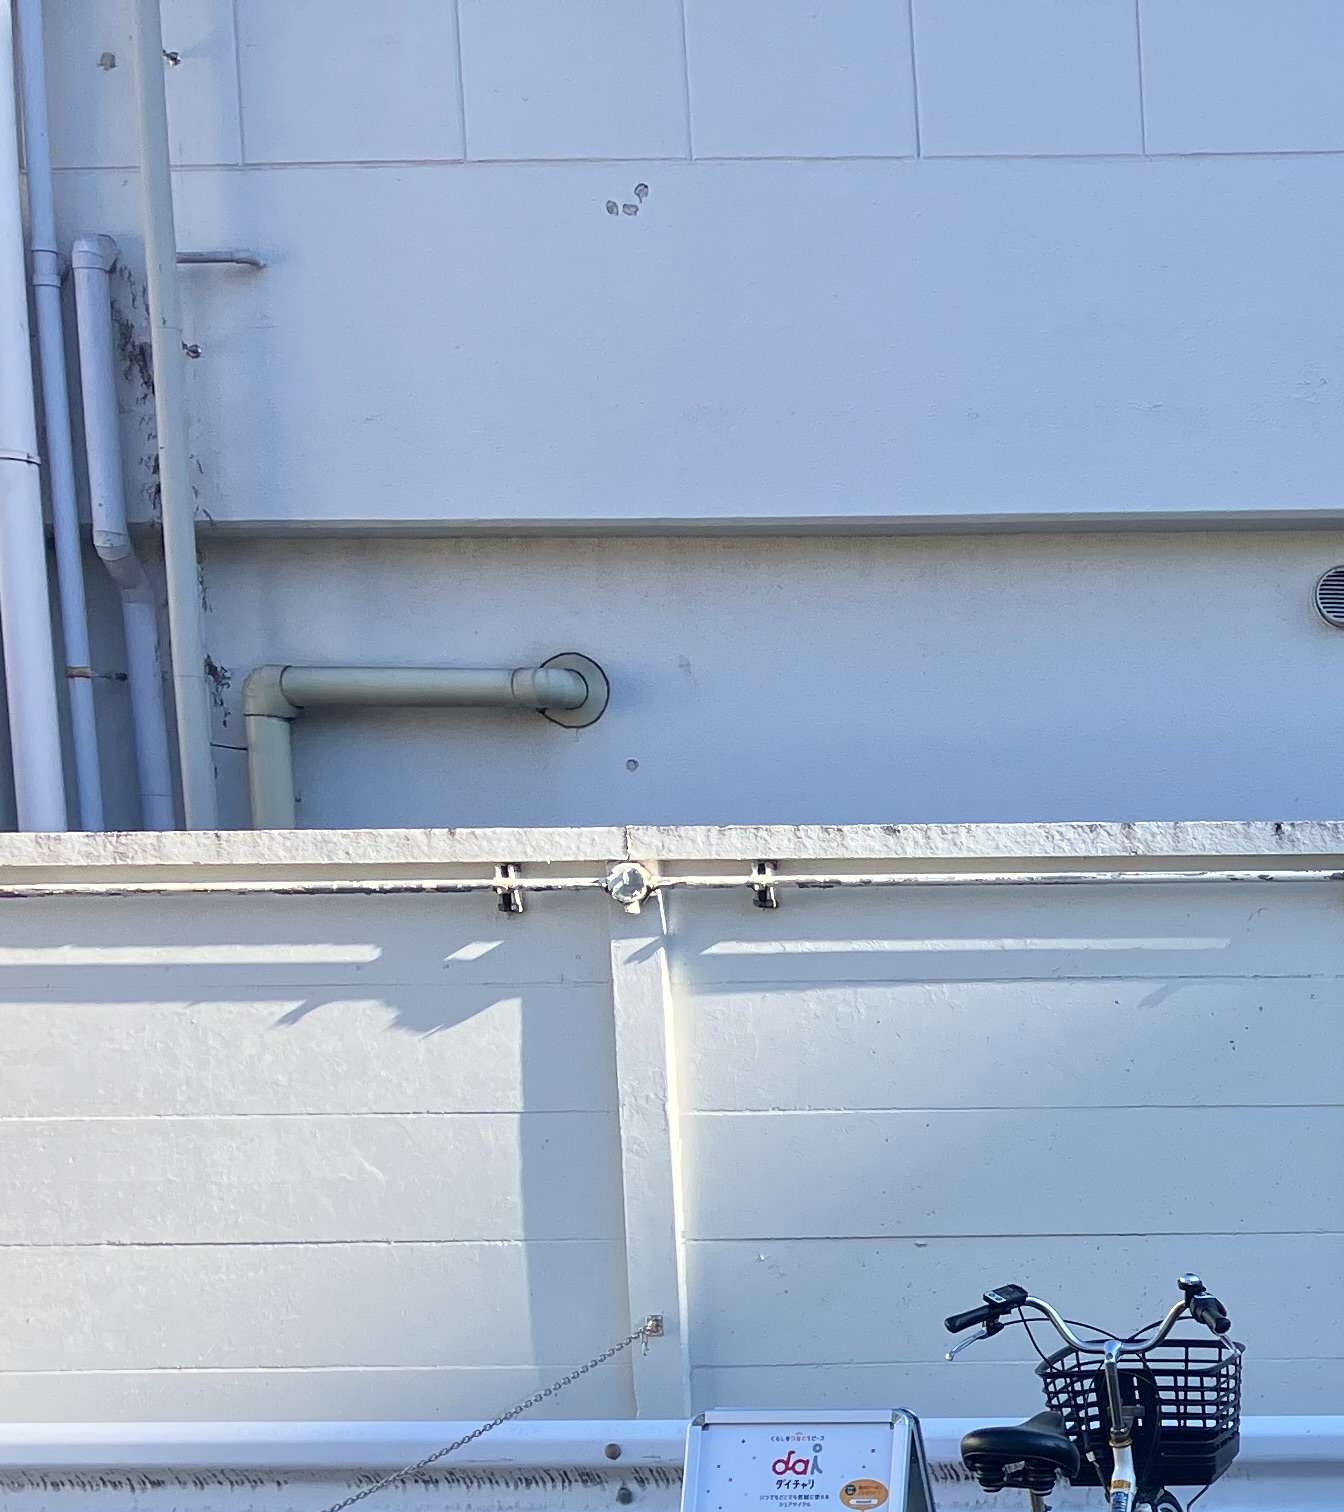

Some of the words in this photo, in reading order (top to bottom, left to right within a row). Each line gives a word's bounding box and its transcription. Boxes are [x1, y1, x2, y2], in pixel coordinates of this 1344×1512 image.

[772, 1443, 823, 1475] dai
[775, 1479, 815, 1490] ダイチャリ
